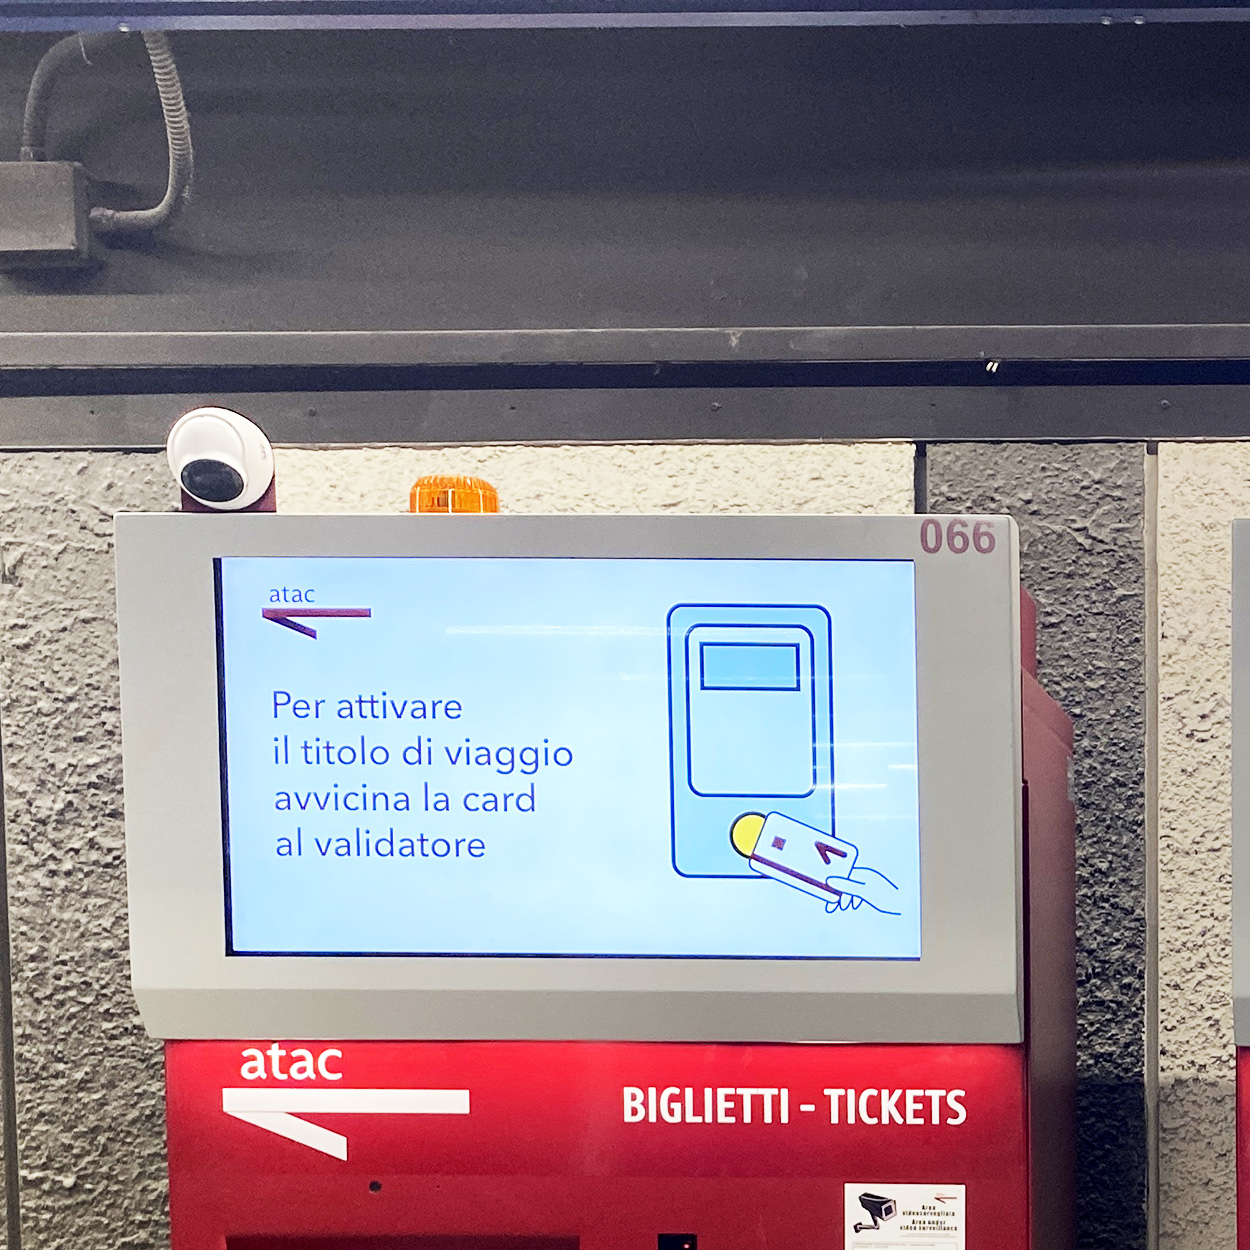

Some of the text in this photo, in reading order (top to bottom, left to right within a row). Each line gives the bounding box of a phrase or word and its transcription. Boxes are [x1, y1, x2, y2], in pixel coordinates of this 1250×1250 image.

[920, 519, 997, 554] 066
[270, 587, 314, 602] atac
[274, 691, 462, 719] Per attivare
[274, 735, 572, 774] il titolo di viaggio
[276, 782, 535, 812] avvicina la card
[277, 827, 485, 857] al validatore
[241, 1043, 342, 1080] atac
[624, 1087, 788, 1123] BIGLIETTI
[824, 1089, 966, 1125] TICKETS
